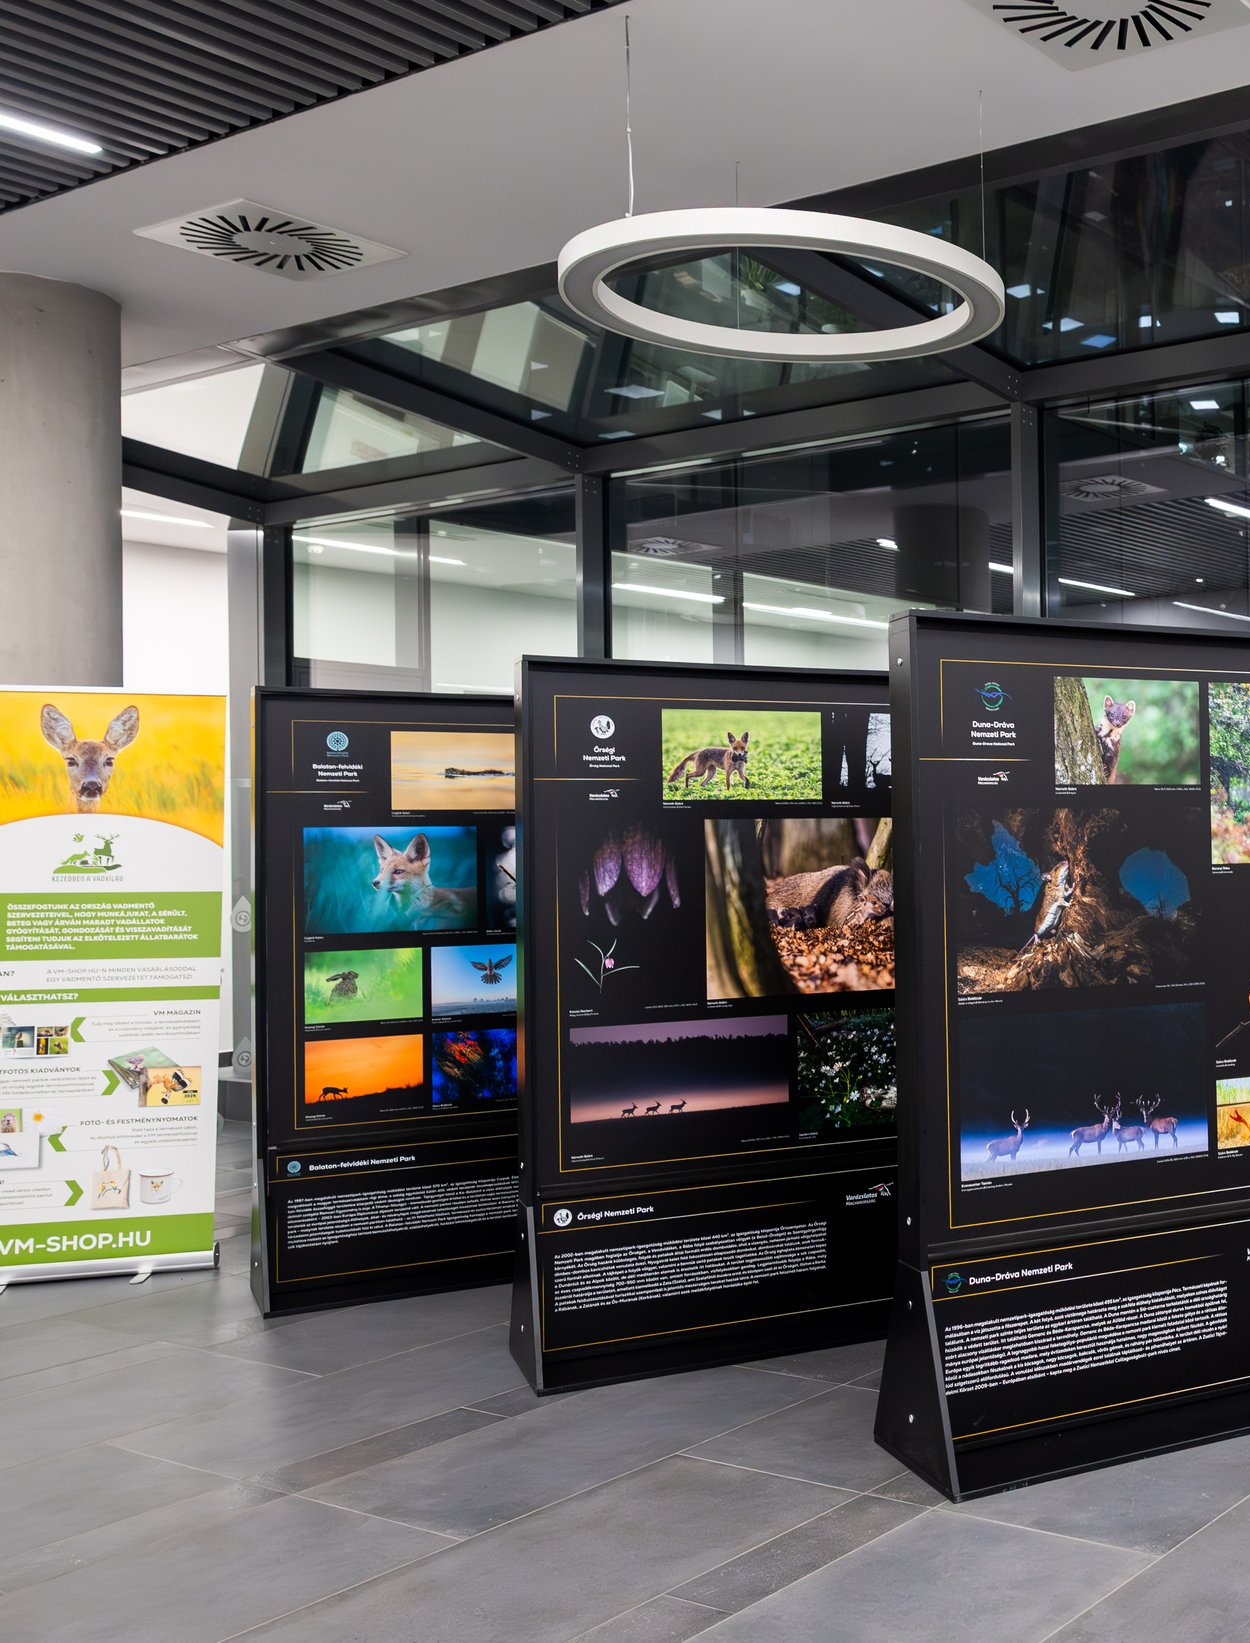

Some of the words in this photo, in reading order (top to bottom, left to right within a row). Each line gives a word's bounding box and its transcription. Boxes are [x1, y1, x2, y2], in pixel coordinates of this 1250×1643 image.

[972, 720, 1014, 728] Duna-Dráva
[54, 918, 81, 926] ÁRVÁN
[140, 932, 198, 940] ÁLLATBARÁTOK
[0, 992, 78, 1002] VÁLASZTHATSZ?
[117, 1116, 198, 1124] FESTMÉNYNYOMATOK
[309, 1160, 370, 1171] Balaton-felvidéki
[370, 1156, 398, 1166] Nemzeti
[577, 1210, 603, 1222] Őrségi
[604, 1207, 635, 1219] Nemzeti
[637, 1205, 654, 1215] Park
[0, 1231, 152, 1256] VM-SHOP.HU
[969, 1270, 1020, 1286] Duna-Dráva
[1022, 1266, 1054, 1278] Nemzeti
[1055, 1262, 1073, 1273] Park
